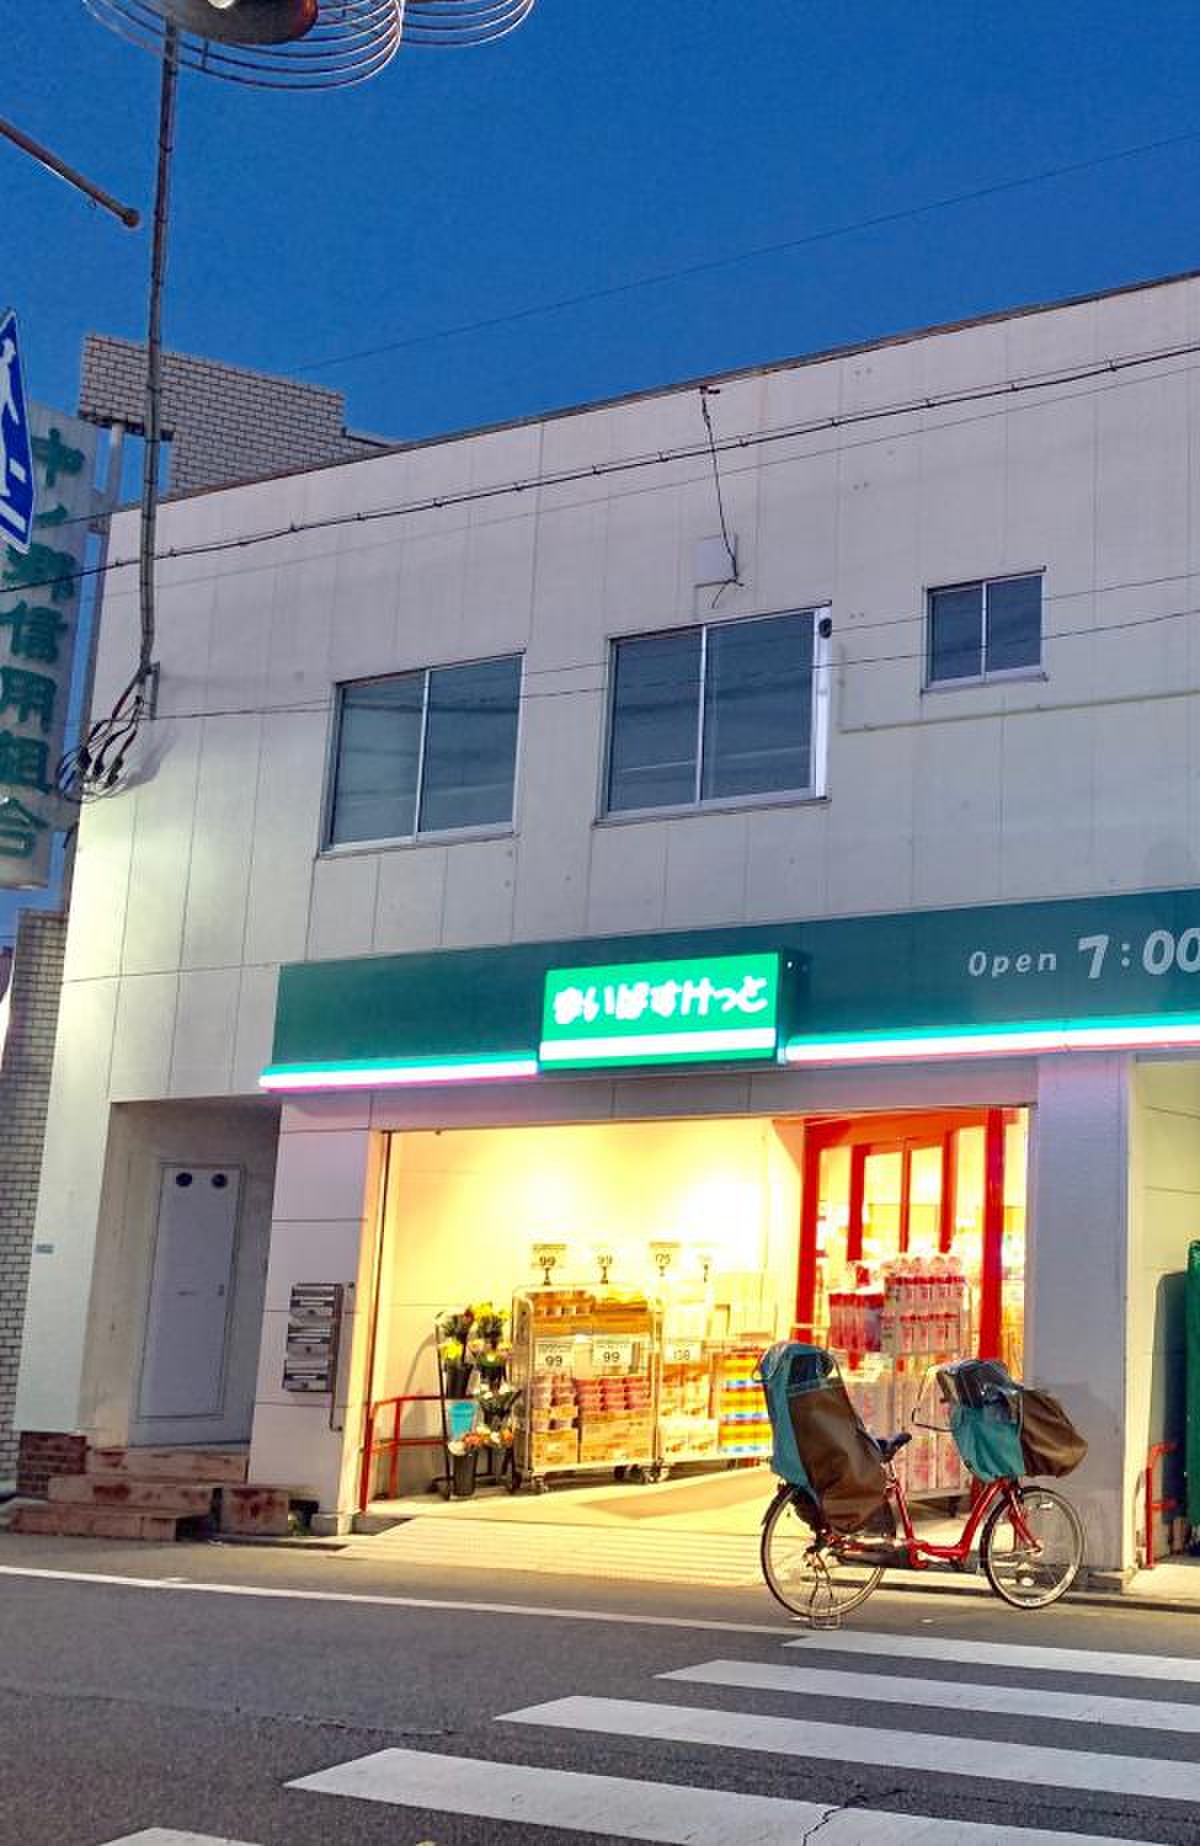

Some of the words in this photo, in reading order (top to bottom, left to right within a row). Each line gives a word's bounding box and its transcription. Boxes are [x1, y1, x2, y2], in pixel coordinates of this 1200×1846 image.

[968, 951, 1058, 979] Open
[553, 975, 769, 1025] まいばすけっと
[545, 1355, 563, 1368] 99
[602, 1350, 621, 1363] 99
